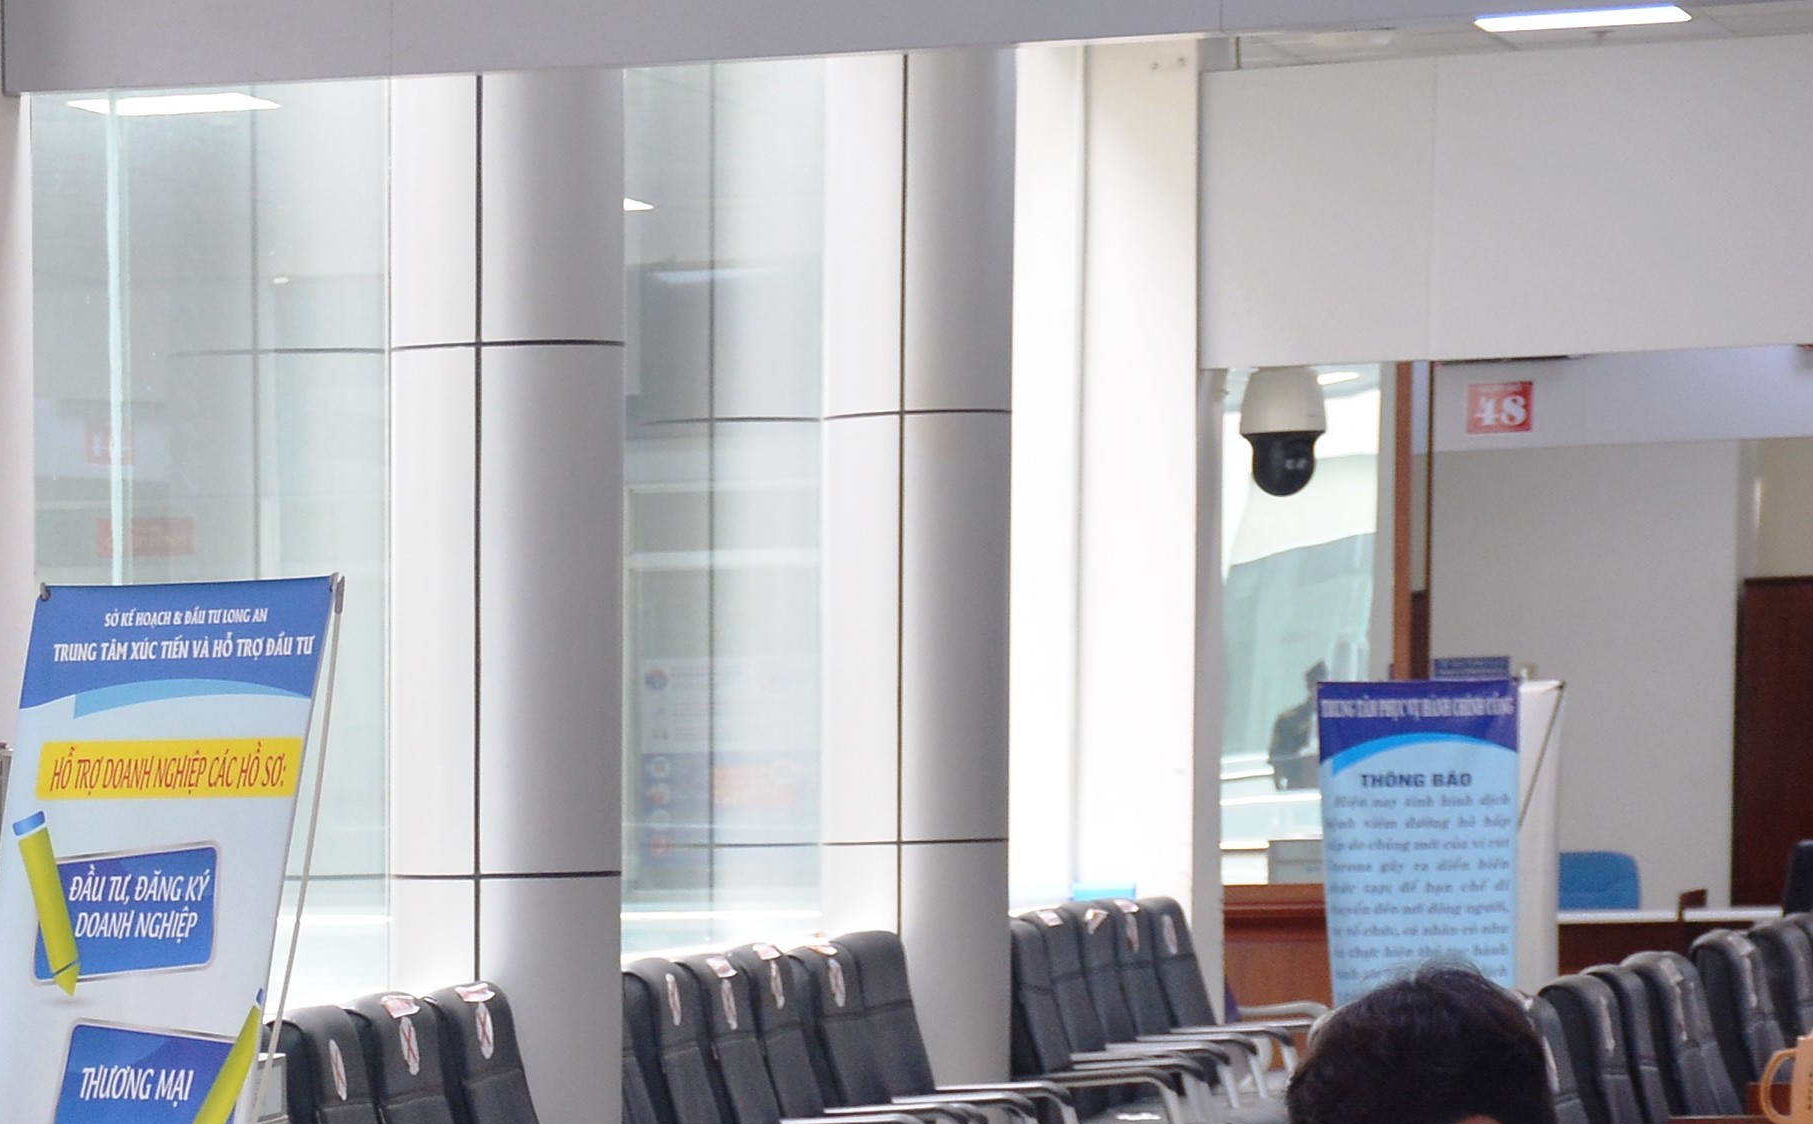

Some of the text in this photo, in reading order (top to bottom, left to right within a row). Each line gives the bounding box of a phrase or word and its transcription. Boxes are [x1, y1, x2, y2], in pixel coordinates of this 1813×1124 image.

[1473, 394, 1527, 427] 48
[104, 611, 120, 628] SỞ
[135, 610, 171, 629] HOẠCH
[173, 611, 182, 625] &
[222, 608, 250, 624] LONG
[251, 607, 268, 623] AN
[53, 643, 97, 662] TRUNG
[100, 638, 128, 661] TÂM
[129, 637, 158, 660] XÚC
[160, 636, 188, 660] TIẾN
[191, 636, 211, 658] VÀ
[211, 631, 234, 658] HỖ
[236, 636, 265, 662] TRỢ
[295, 635, 316, 656] TƯ
[74, 756, 102, 796] TRỢ
[102, 755, 155, 791] DOANH
[154, 749, 208, 795] NGHIỆP
[208, 748, 238, 789] CÁC
[236, 741, 263, 790] HỒ
[1361, 768, 1472, 788] THÔNG BÁO
[68, 864, 211, 905] ĐẦU TƯ, ĐĂNG KÝ
[73, 906, 198, 944] DOANH NGHIỆP
[78, 1066, 195, 1107] THƯƠNG MẠI
